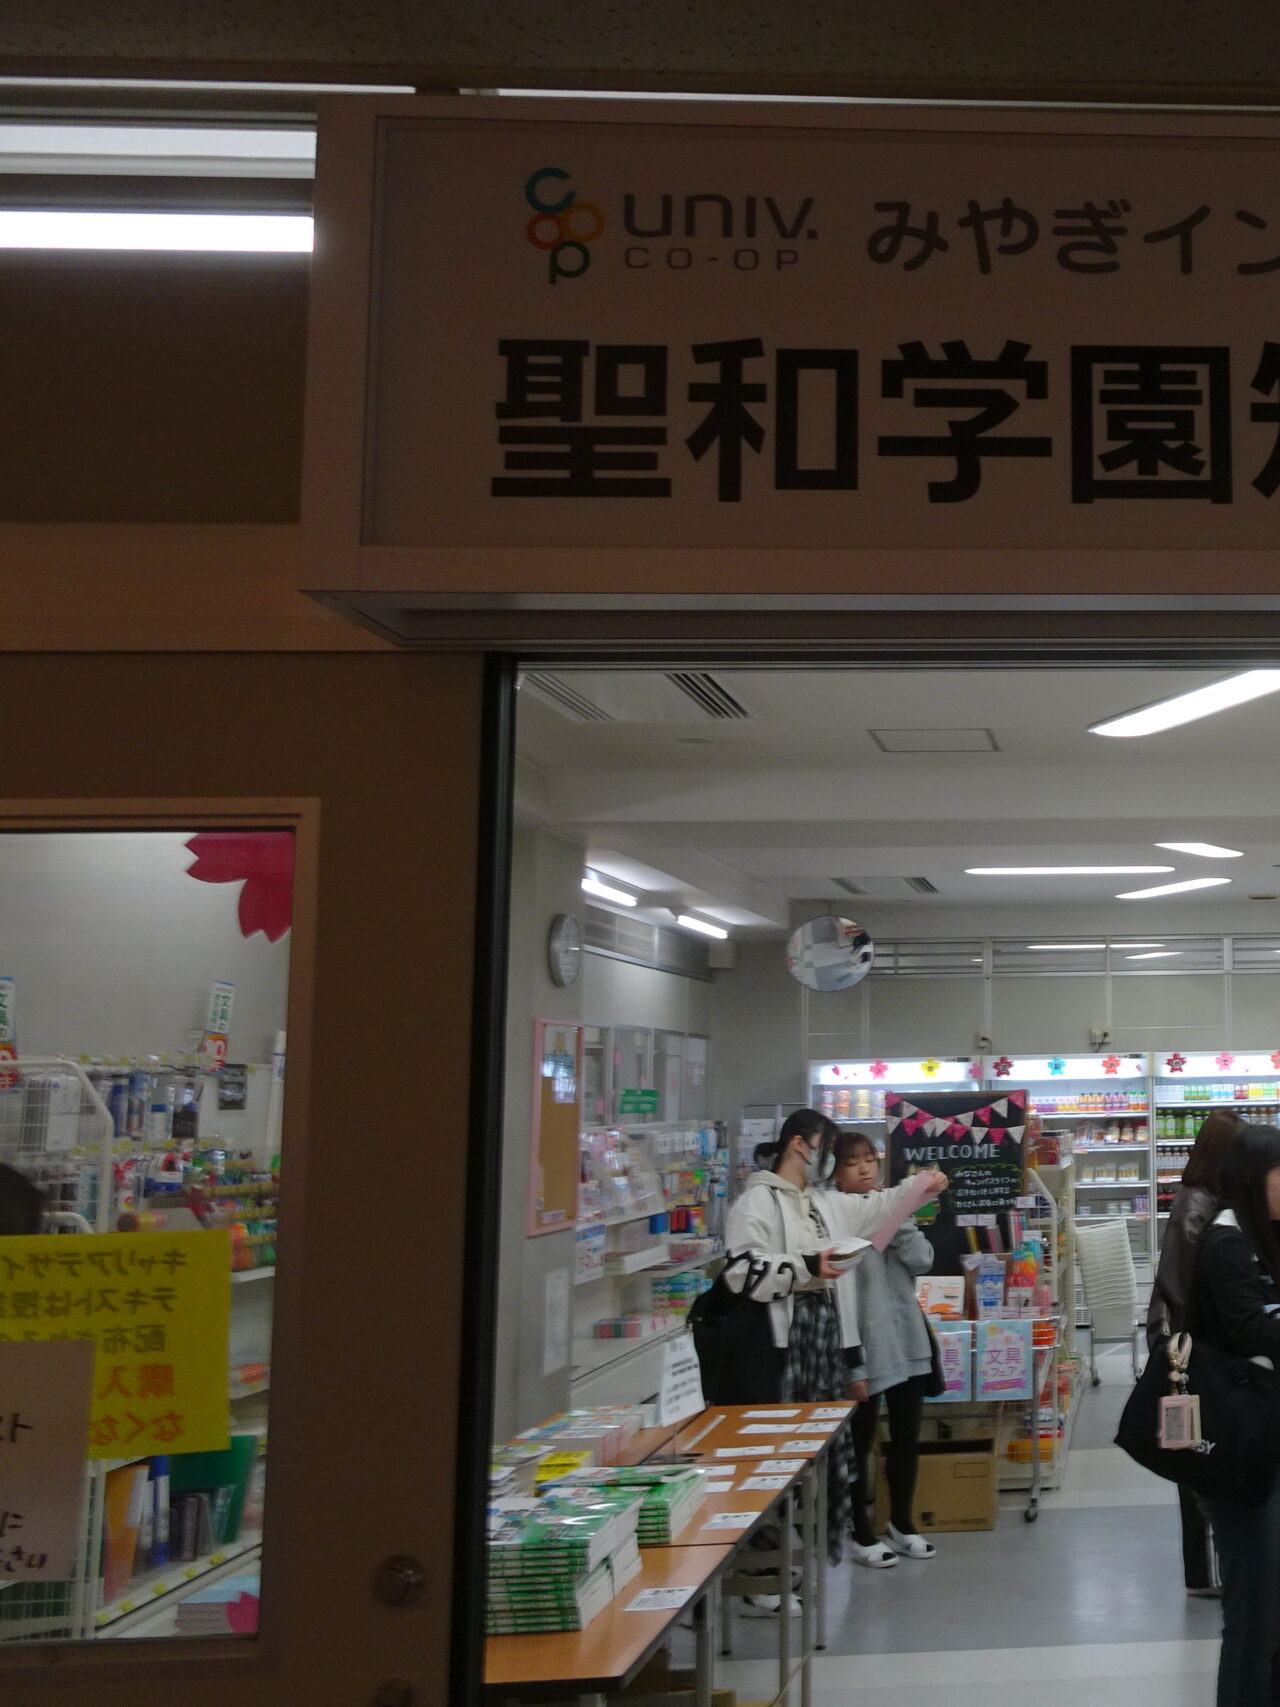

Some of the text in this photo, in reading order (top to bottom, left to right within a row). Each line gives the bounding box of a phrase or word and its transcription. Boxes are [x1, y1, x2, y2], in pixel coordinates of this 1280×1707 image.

[624, 246, 800, 272] CO-OP
[903, 1143, 1001, 1161] WELCOME
[986, 1347, 1021, 1365] 文具
[991, 1366, 1018, 1378] フェア
